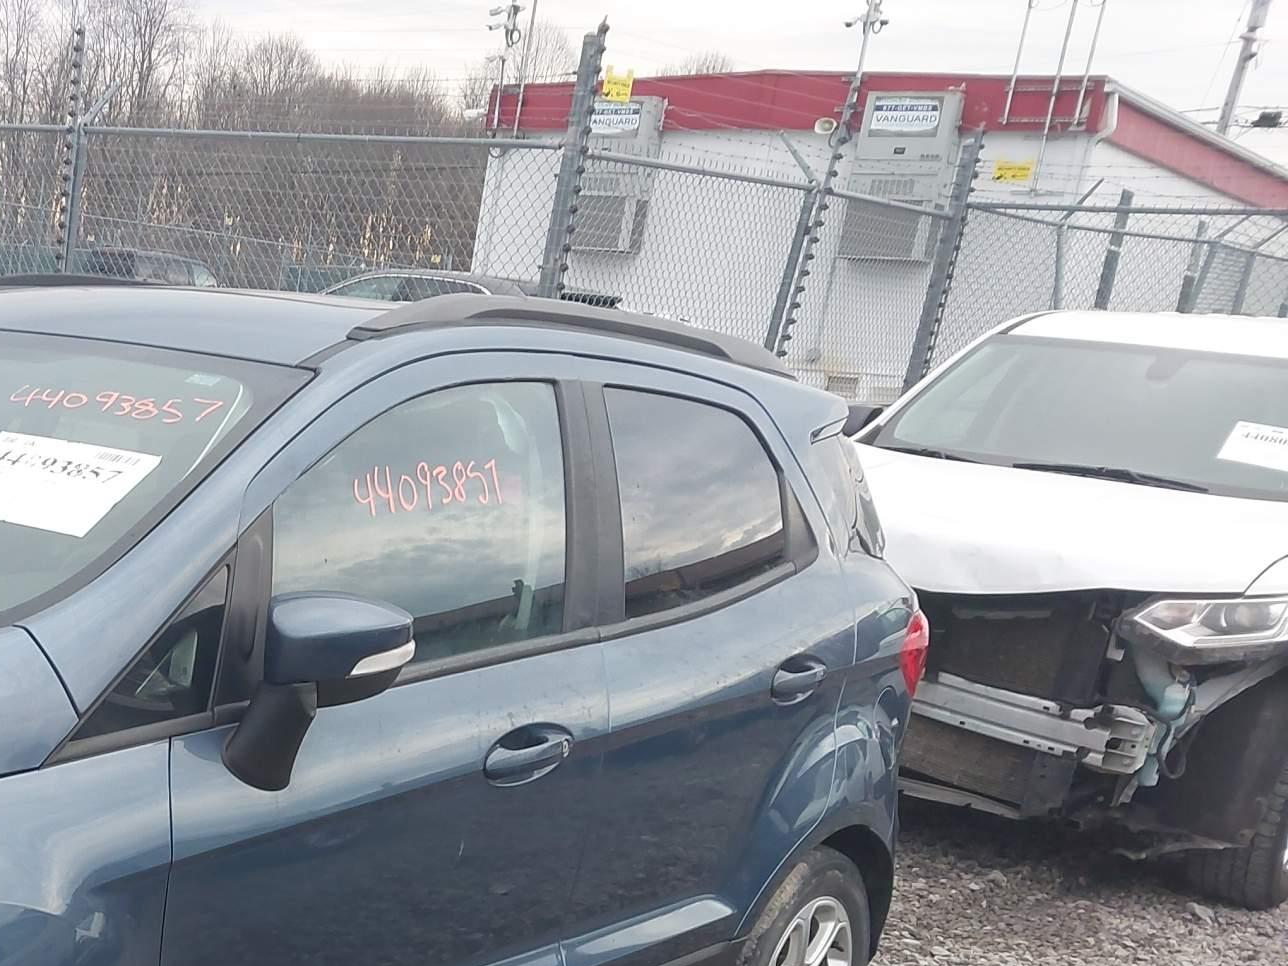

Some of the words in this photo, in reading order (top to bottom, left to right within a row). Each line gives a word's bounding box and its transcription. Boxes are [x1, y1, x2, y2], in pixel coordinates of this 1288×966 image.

[592, 117, 638, 127] ANGUARD
[876, 114, 937, 123] VANGUARD
[9, 384, 224, 423] 44093857
